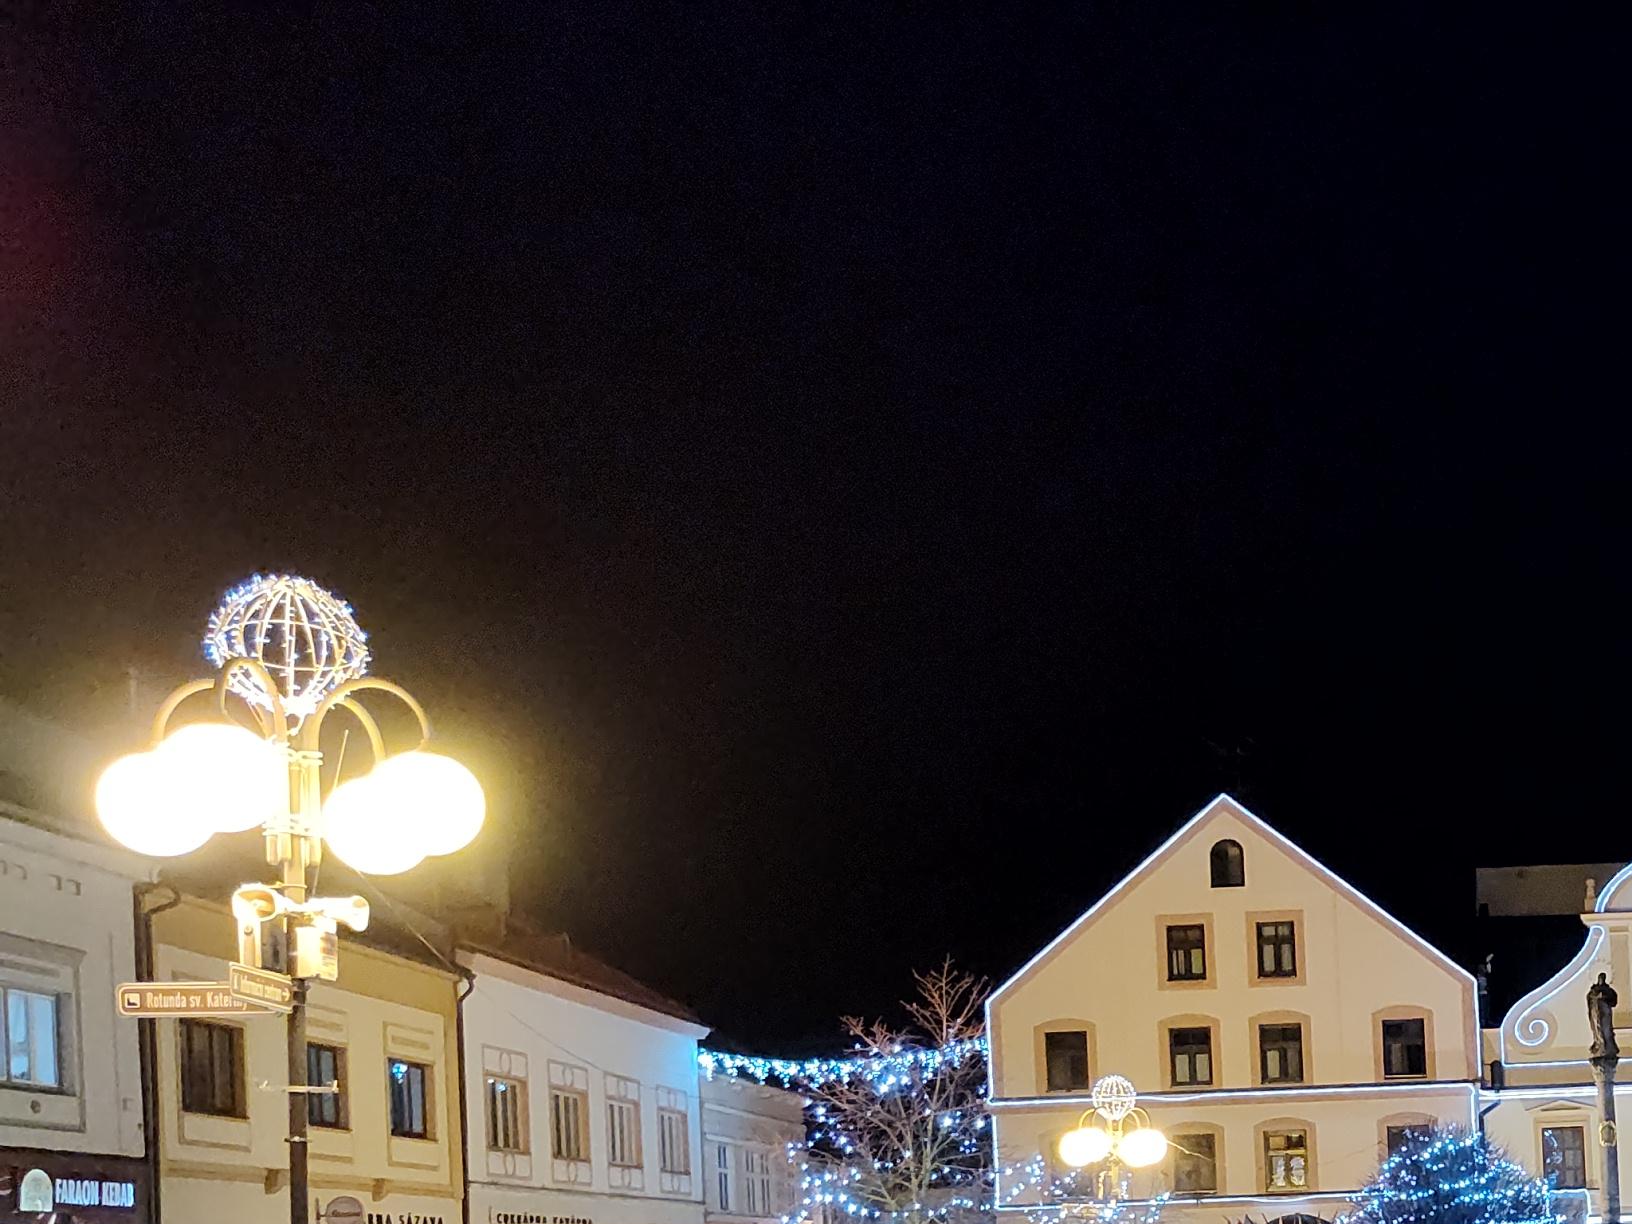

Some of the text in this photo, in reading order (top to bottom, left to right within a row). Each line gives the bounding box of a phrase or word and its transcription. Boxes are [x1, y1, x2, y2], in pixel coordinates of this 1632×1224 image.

[146, 992, 187, 1008] Rotunda
[189, 996, 203, 1008] sv.
[55, 1179, 135, 1208] FARAON KEBAB
